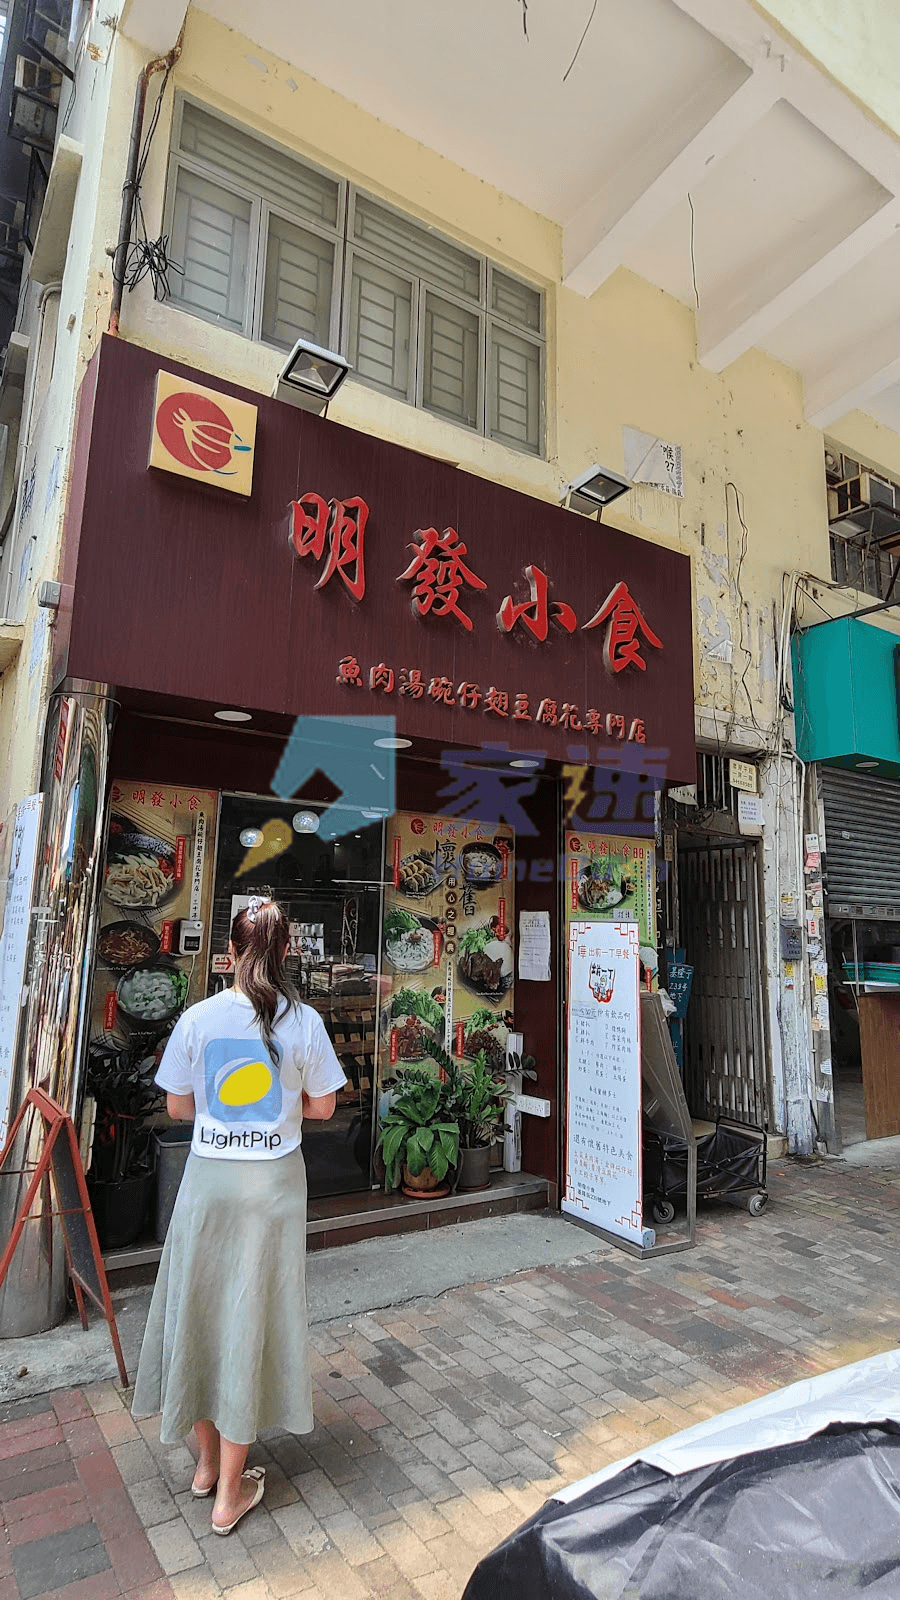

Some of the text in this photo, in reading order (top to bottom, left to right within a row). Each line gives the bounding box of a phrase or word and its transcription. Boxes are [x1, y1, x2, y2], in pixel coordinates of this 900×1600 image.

[288, 492, 664, 673] 明發小食
[335, 655, 647, 744] 魚肉湯碗仔翅豆腐花專門店
[132, 789, 201, 811] 明發小食
[433, 821, 486, 841] 明發小食
[200, 1126, 282, 1150] LightPip
